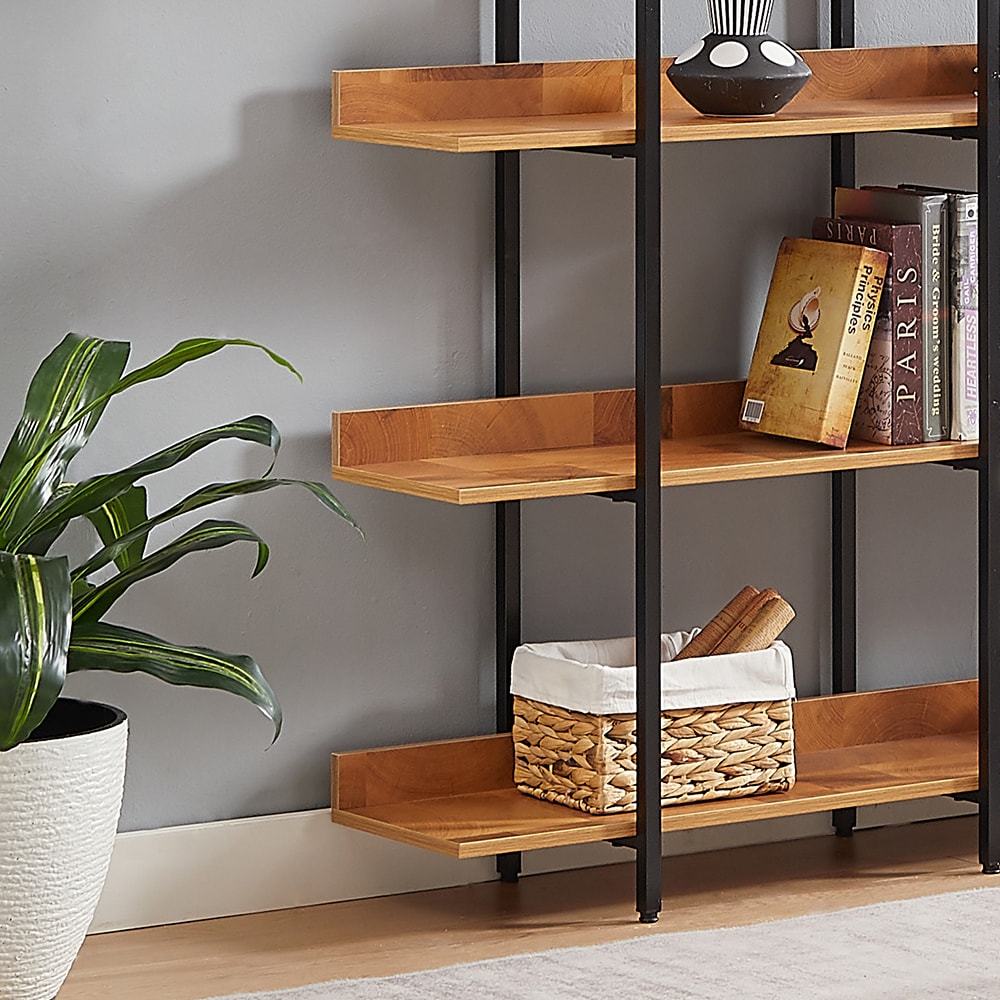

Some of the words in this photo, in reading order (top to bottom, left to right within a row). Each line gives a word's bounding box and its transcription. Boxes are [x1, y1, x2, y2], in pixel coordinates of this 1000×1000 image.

[826, 221, 877, 245] PARIS
[932, 224, 941, 265] Bride
[848, 265, 873, 335] Principles
[862, 275, 884, 331] Physics
[932, 268, 941, 282] &
[896, 267, 918, 403] PARIS
[966, 314, 977, 398] HEARTLESS
[931, 356, 941, 417] wedding
